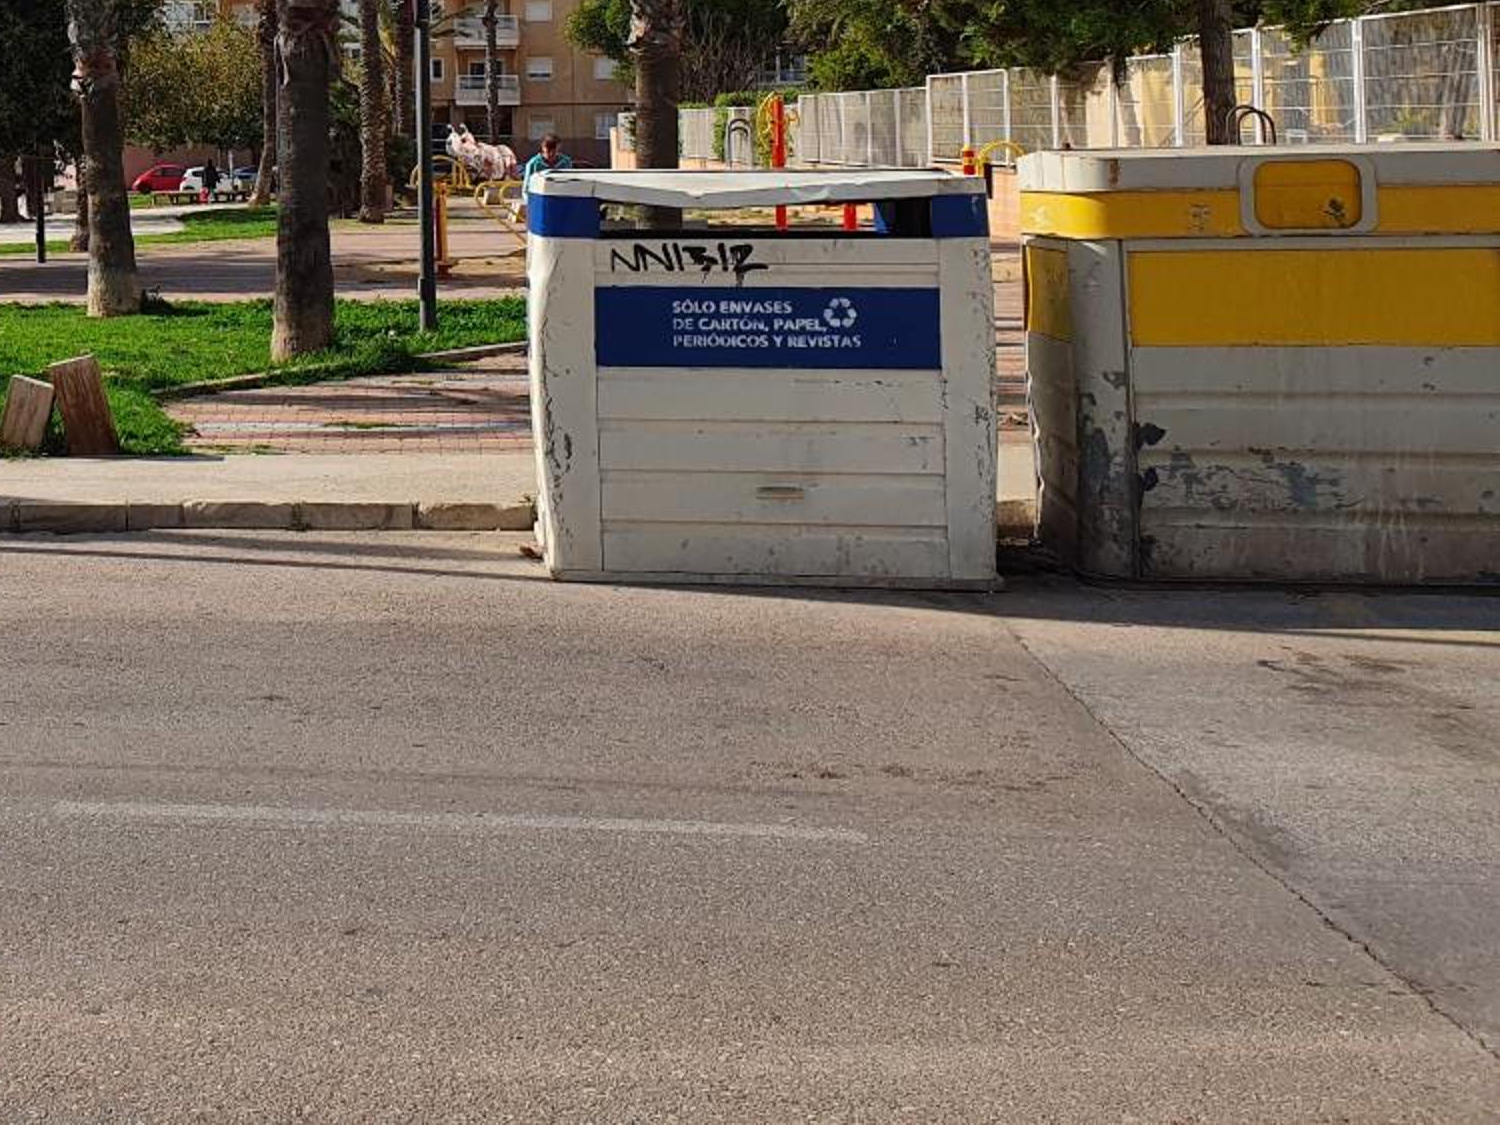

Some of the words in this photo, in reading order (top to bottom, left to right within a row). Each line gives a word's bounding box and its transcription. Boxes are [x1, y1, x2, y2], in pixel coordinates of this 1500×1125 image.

[672, 299, 715, 314] SÓLO
[719, 301, 793, 314] ENVASES
[673, 318, 694, 330] DE
[699, 315, 769, 332] CARTÓN,
[773, 318, 828, 332] PAPEL,
[673, 332, 769, 348] PERIÓDICOS
[774, 335, 786, 347] Y
[788, 335, 861, 348] REVISTAS
